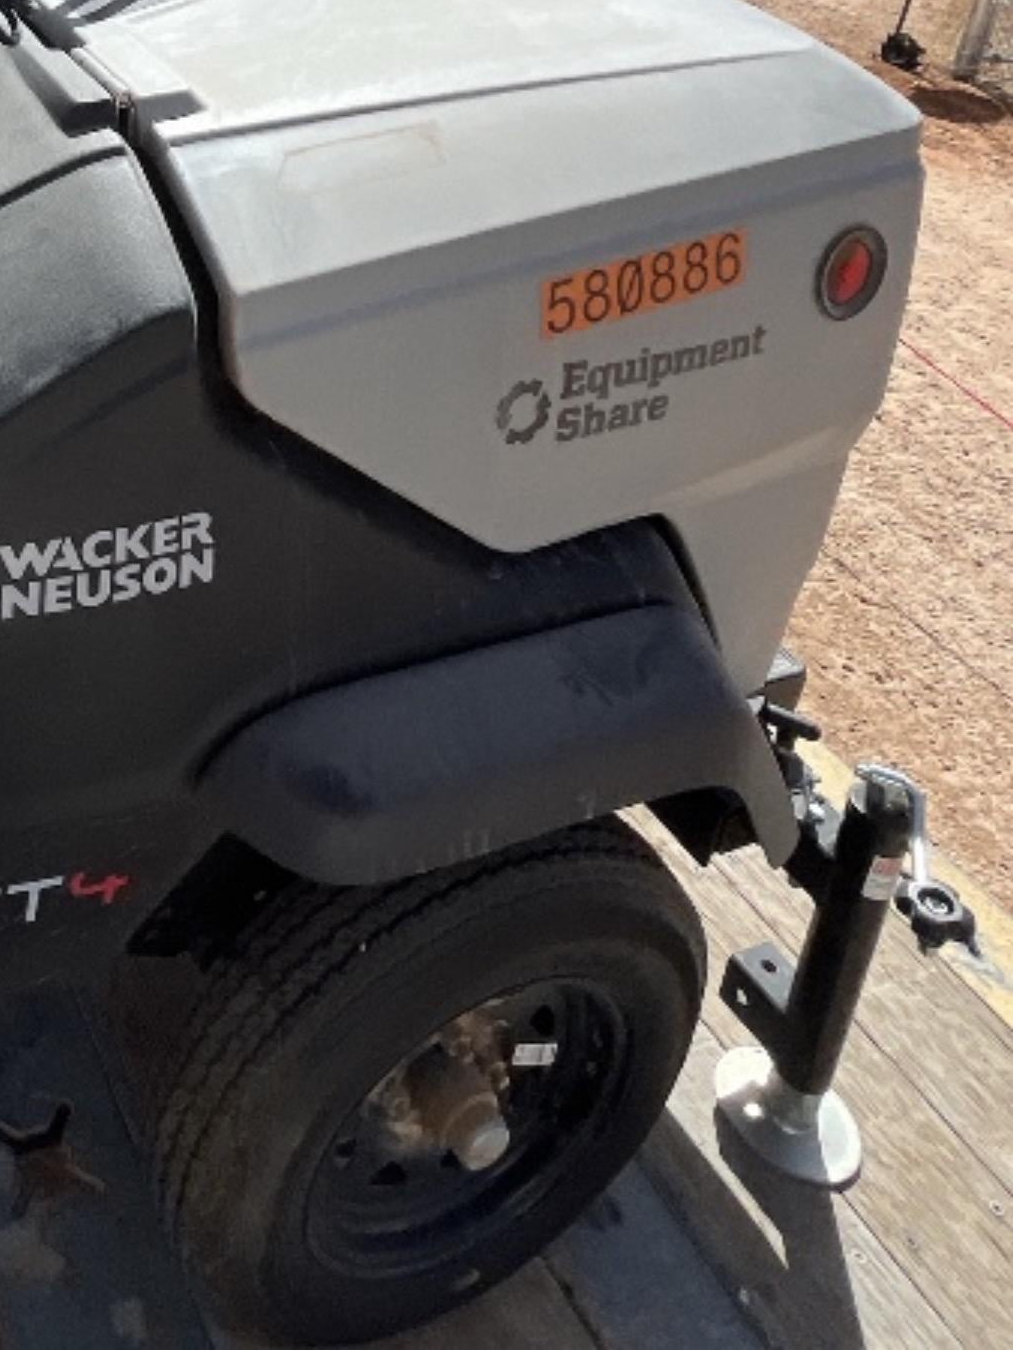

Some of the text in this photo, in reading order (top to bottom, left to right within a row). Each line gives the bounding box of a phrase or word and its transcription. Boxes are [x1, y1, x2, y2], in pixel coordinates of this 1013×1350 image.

[546, 231, 743, 335] 580886
[560, 325, 768, 400] Equipment
[554, 393, 670, 442] Share
[1, 548, 215, 620] NEUSON
